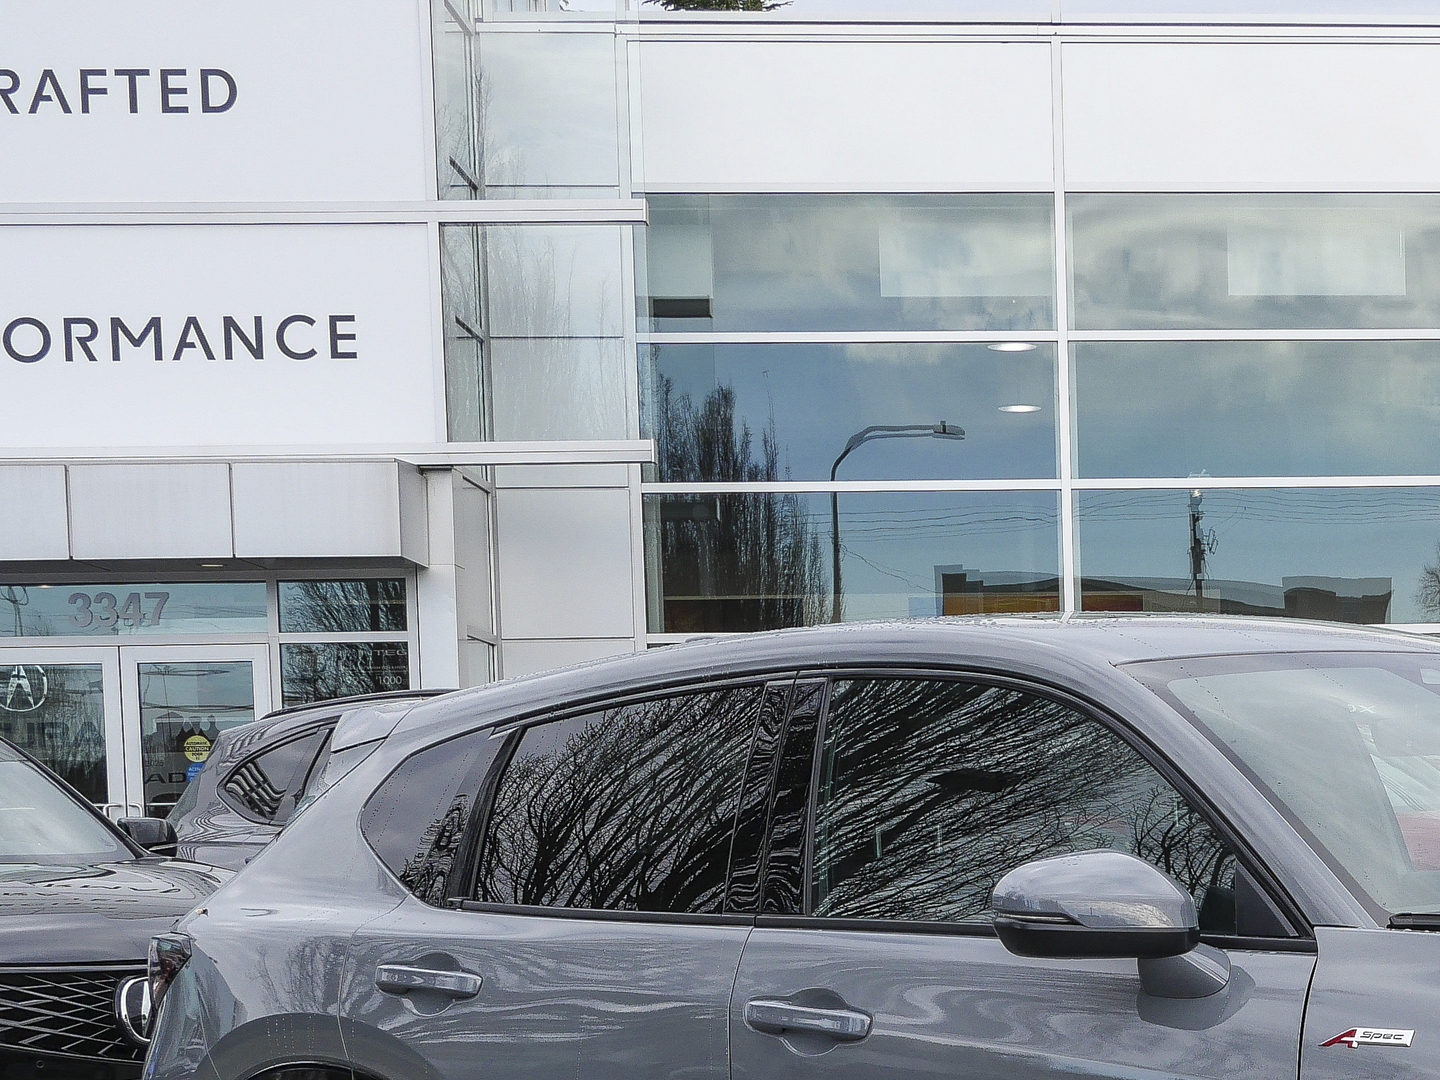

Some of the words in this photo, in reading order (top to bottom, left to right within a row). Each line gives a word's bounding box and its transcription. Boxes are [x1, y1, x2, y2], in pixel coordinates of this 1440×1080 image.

[0, 68, 238, 115] RAFTED
[2, 314, 358, 364] ORMANCE
[68, 591, 170, 627] 3347
